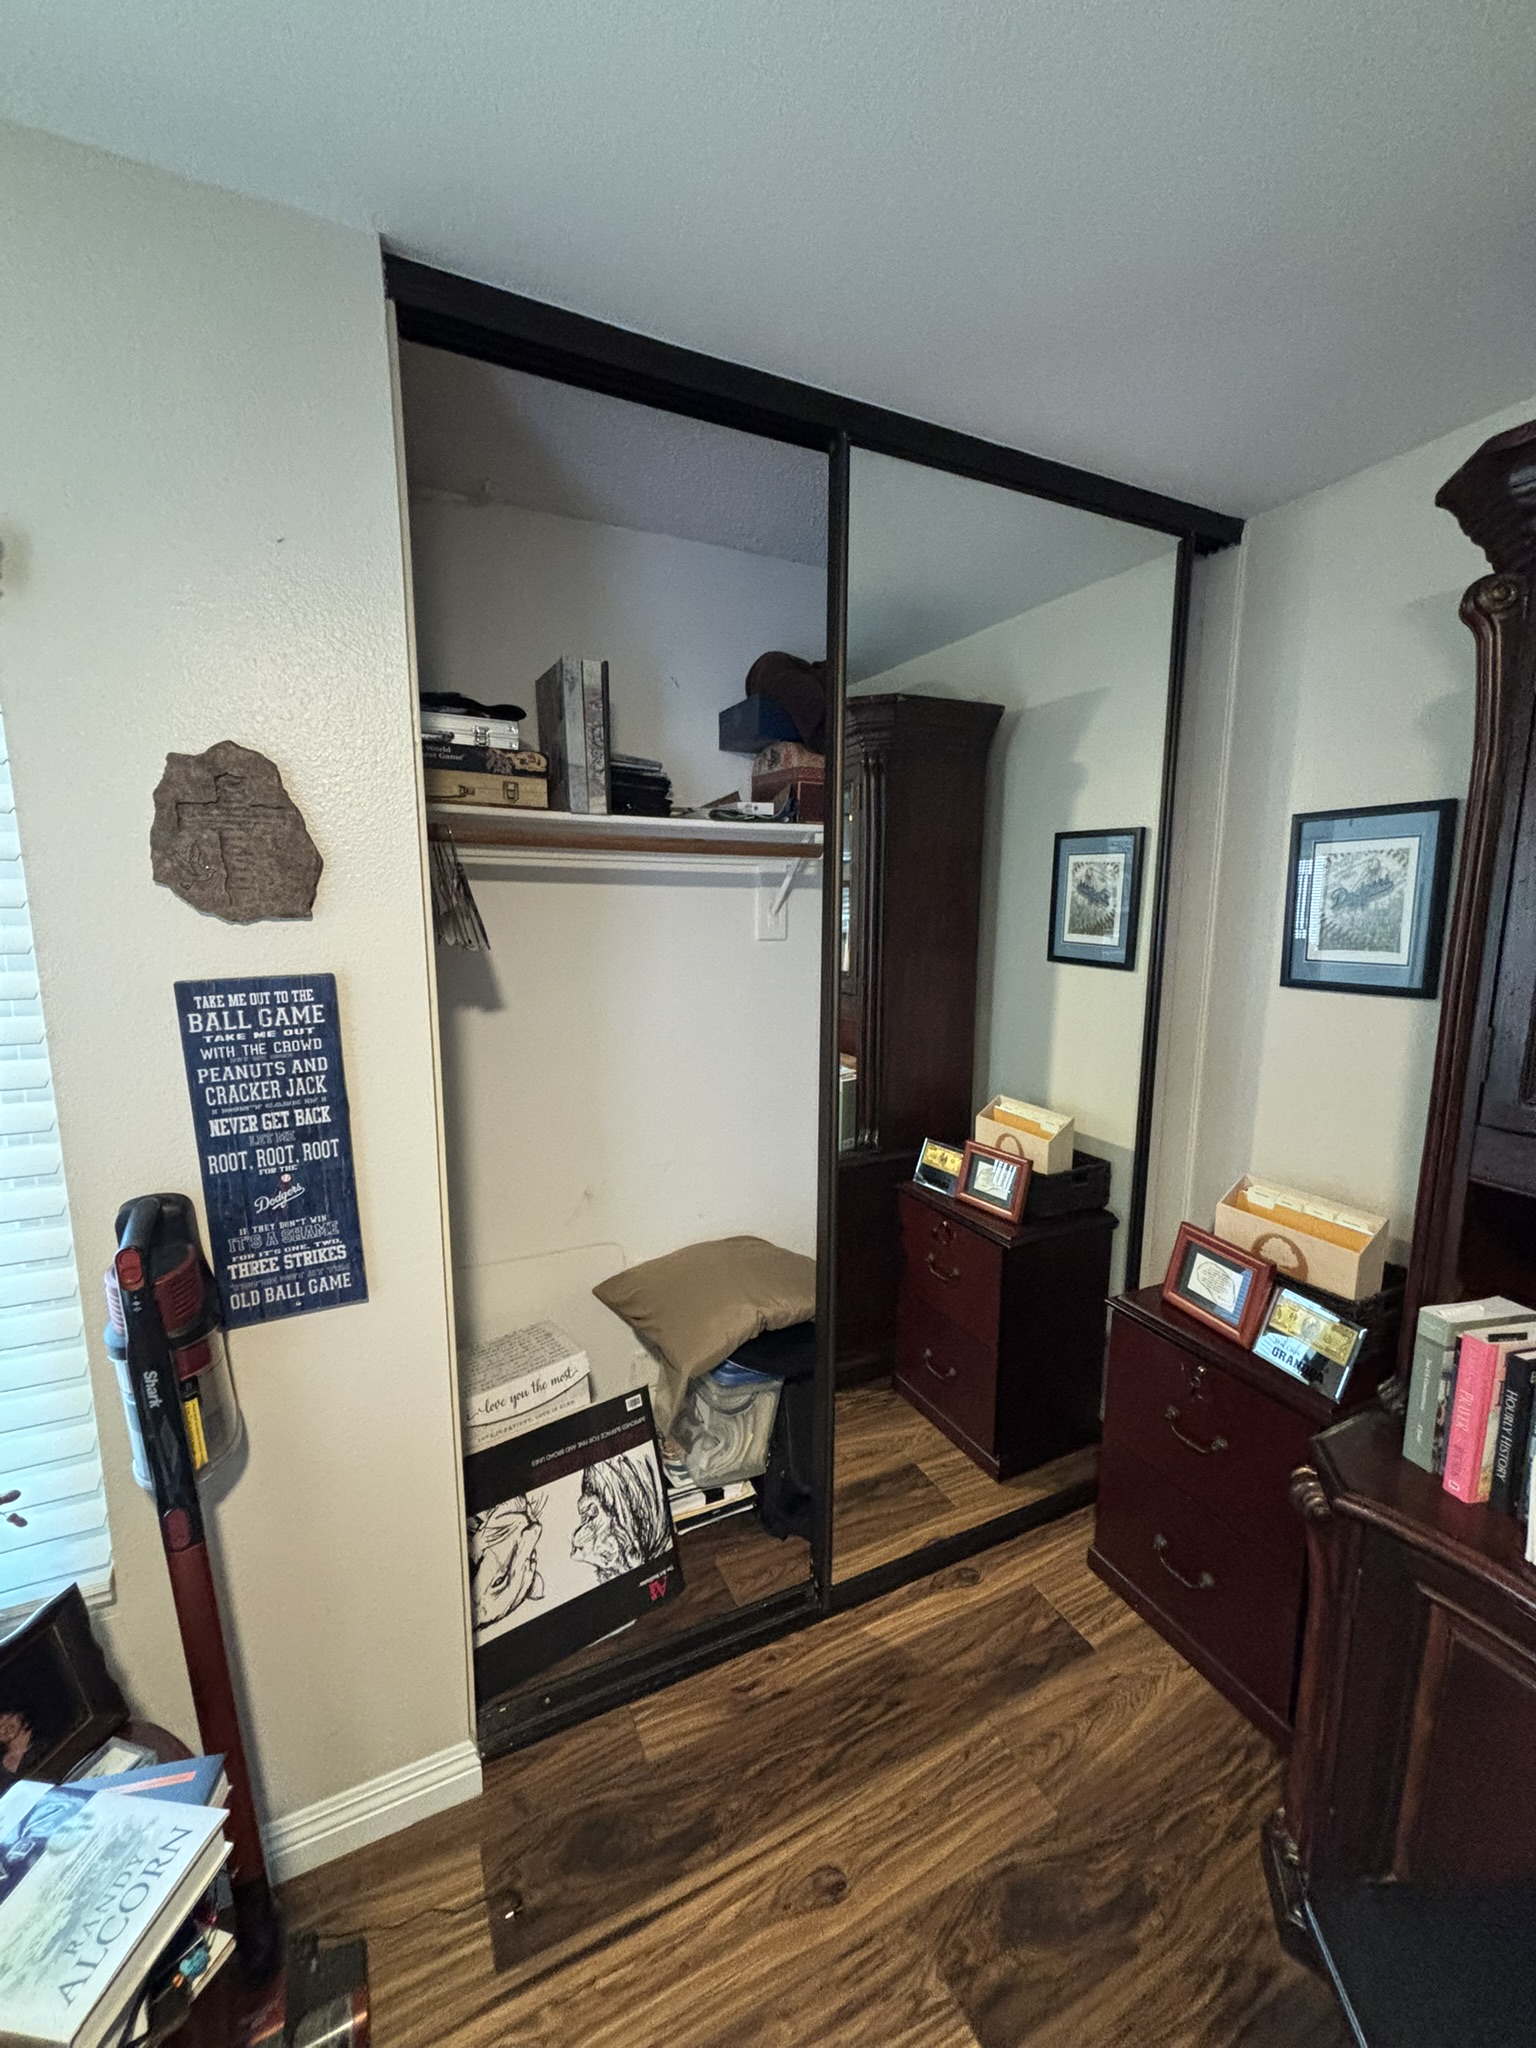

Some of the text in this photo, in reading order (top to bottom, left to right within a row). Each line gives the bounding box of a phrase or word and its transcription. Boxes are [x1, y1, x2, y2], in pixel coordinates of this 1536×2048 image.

[193, 989, 314, 1009] TAKE ME OUT TO THE
[187, 1004, 325, 1033] BALL GAME
[200, 1046, 236, 1060] WITH
[241, 1043, 267, 1056] THE
[273, 1038, 322, 1054] CROWD
[202, 1027, 315, 1043] TAKE ME OUT
[197, 1061, 286, 1084] PEANUTS
[291, 1056, 328, 1075] AND
[205, 1075, 327, 1106] CRACKER JACK
[208, 1106, 332, 1137] NEVER GET BACK
[208, 1138, 340, 1175] ROOT, ROOT, ROOT
[258, 1164, 298, 1176] FOR THE
[254, 1183, 305, 1214] Dodgers
[228, 1221, 340, 1253] IT'S A SHAME
[252, 1223, 275, 1233] THEY
[279, 1218, 306, 1229] DON'T
[309, 1214, 327, 1224] WIN
[227, 1245, 347, 1280] THREE STRIKES
[231, 1254, 255, 1263] FOR
[258, 1249, 282, 1258] IT'S
[230, 1290, 260, 1310] OLD
[264, 1282, 305, 1303] BALL
[308, 1272, 352, 1295] GAME
[143, 1370, 163, 1409] Shark
[478, 1399, 507, 1414] love
[510, 1390, 530, 1410] you
[530, 1378, 548, 1394] the
[551, 1366, 578, 1386] most
[531, 1416, 646, 1468] IMPROVED SURFACE FOR FINE AND BROAD LINES
[1496, 1389, 1518, 1482] HOURLY HISTORY
[58, 1825, 193, 2008] ALCORN
[63, 1853, 144, 1956] RANDY
